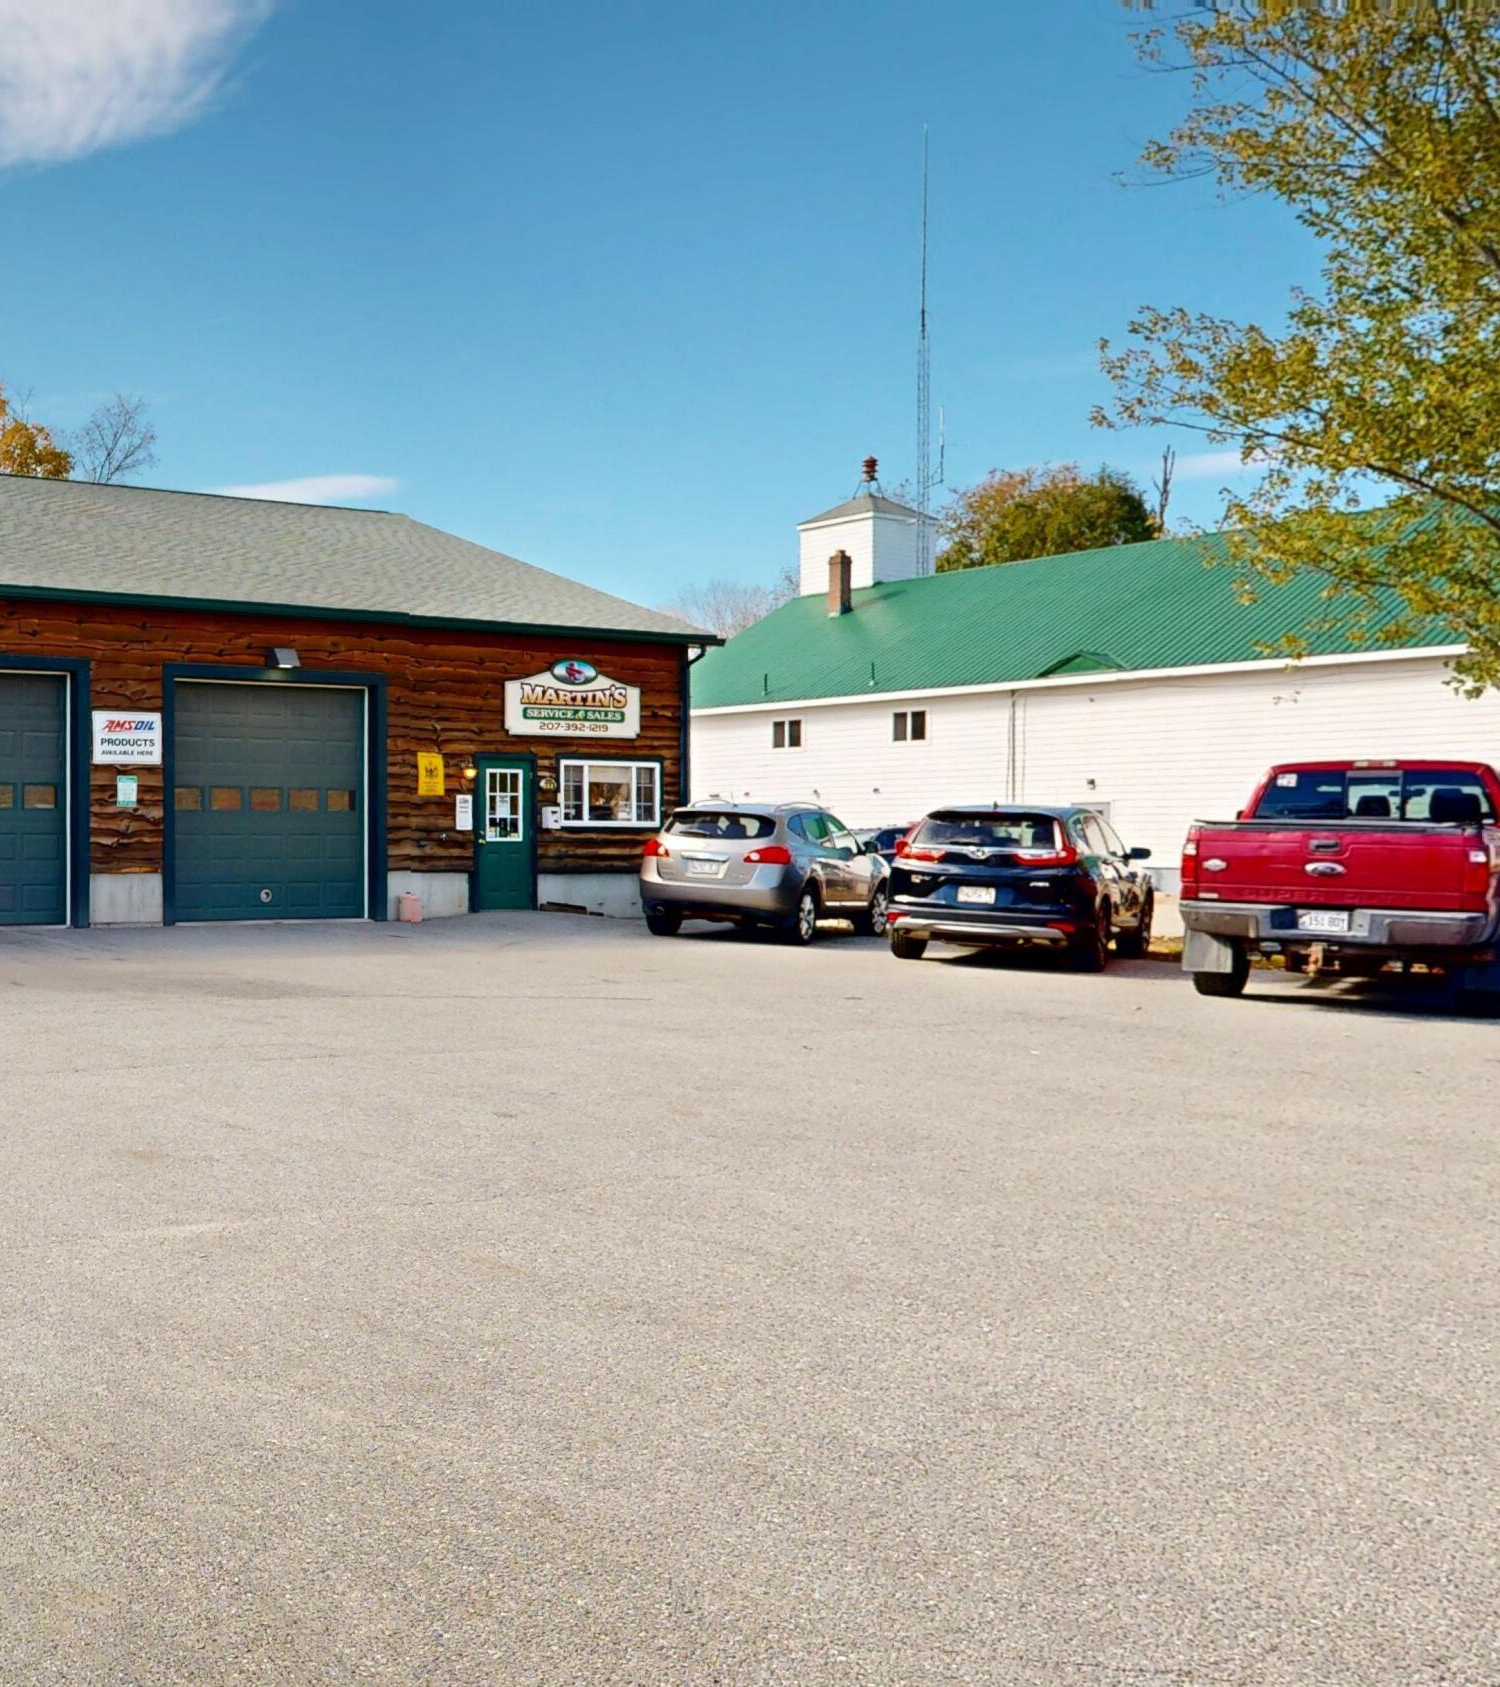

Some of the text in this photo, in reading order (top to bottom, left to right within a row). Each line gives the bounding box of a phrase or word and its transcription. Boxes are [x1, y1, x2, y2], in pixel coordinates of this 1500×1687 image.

[520, 681, 627, 709] MARTIN'S
[526, 708, 574, 719] SERVICE
[586, 710, 622, 721] SALES
[102, 719, 156, 733] AMSOIL
[539, 722, 609, 733] 207-392-1219
[100, 737, 156, 747] PRODUCTS
